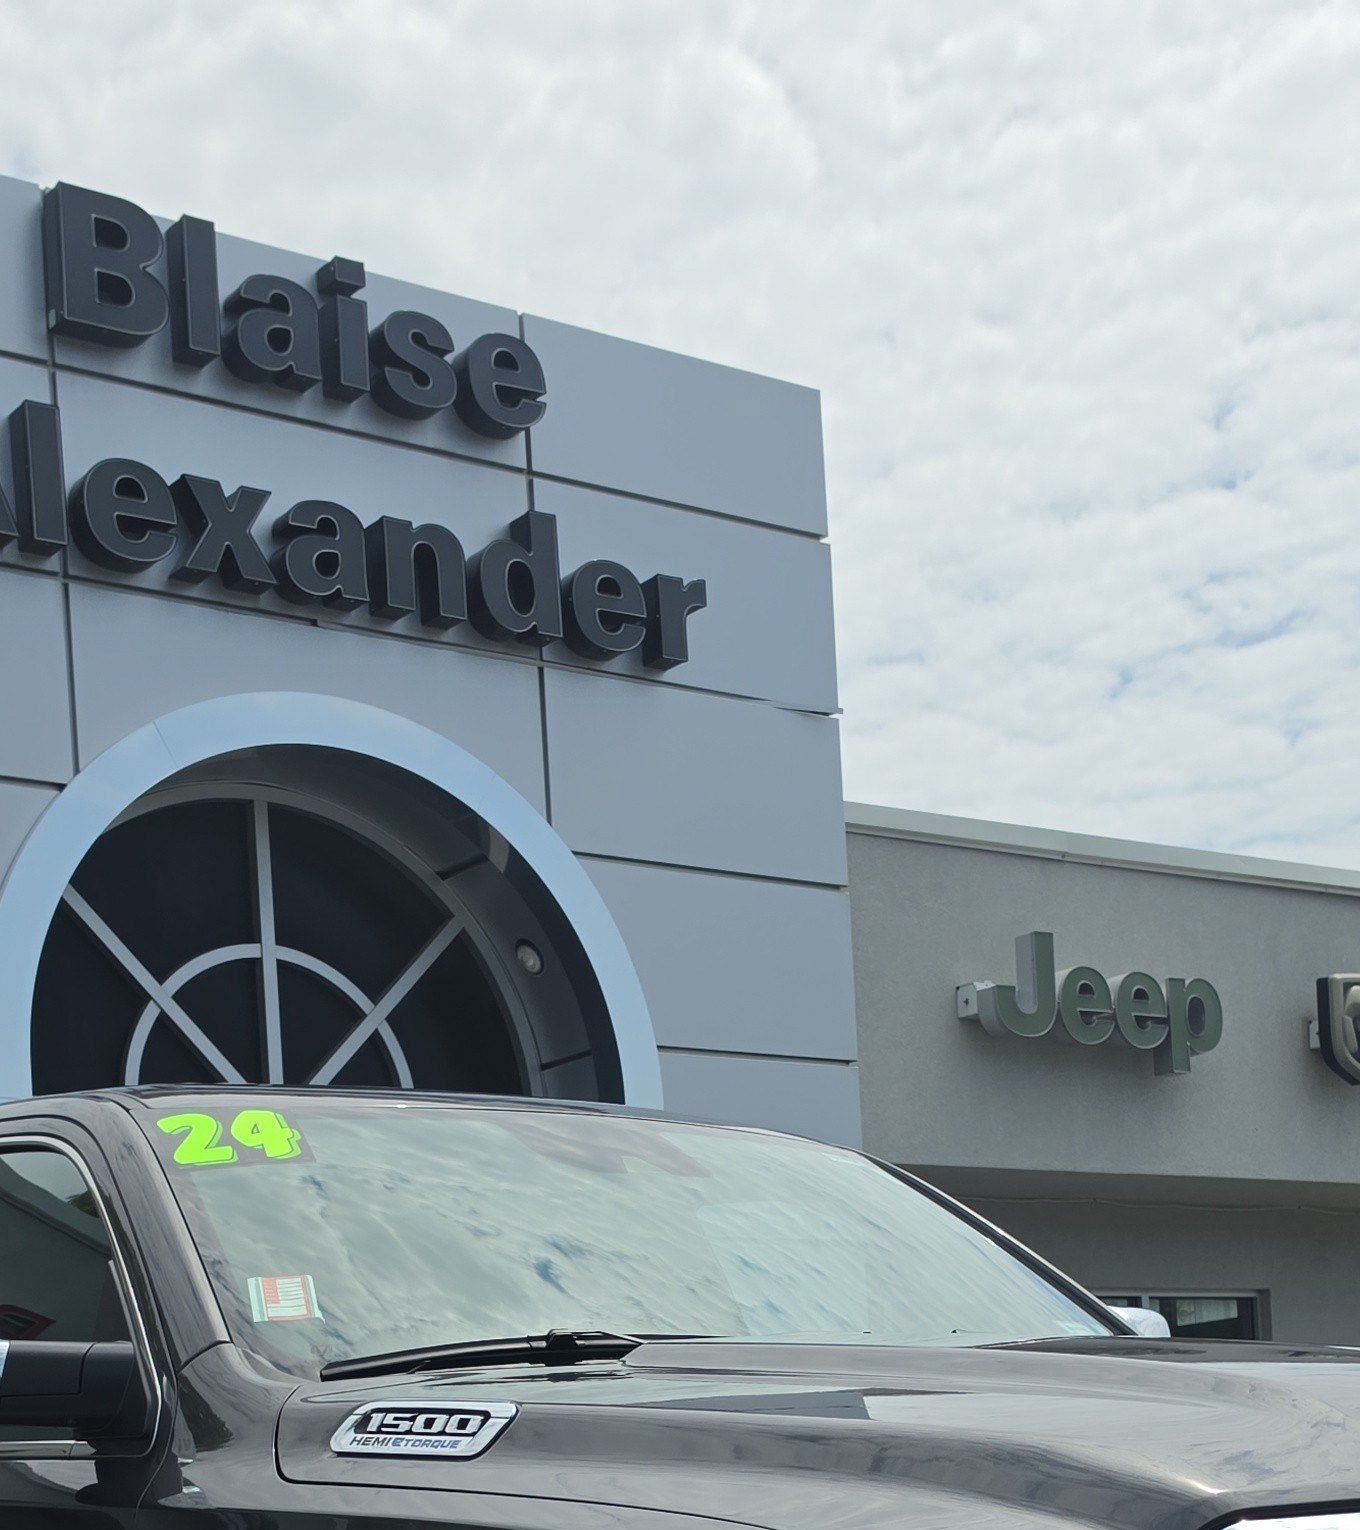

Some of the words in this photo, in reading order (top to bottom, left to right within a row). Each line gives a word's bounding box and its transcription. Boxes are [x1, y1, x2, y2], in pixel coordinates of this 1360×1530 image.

[42, 180, 547, 440] Blaise
[978, 931, 1224, 1075] Jeep
[157, 1109, 302, 1165] 24
[349, 1436, 392, 1447] HEMI
[366, 1412, 484, 1433] 1500
